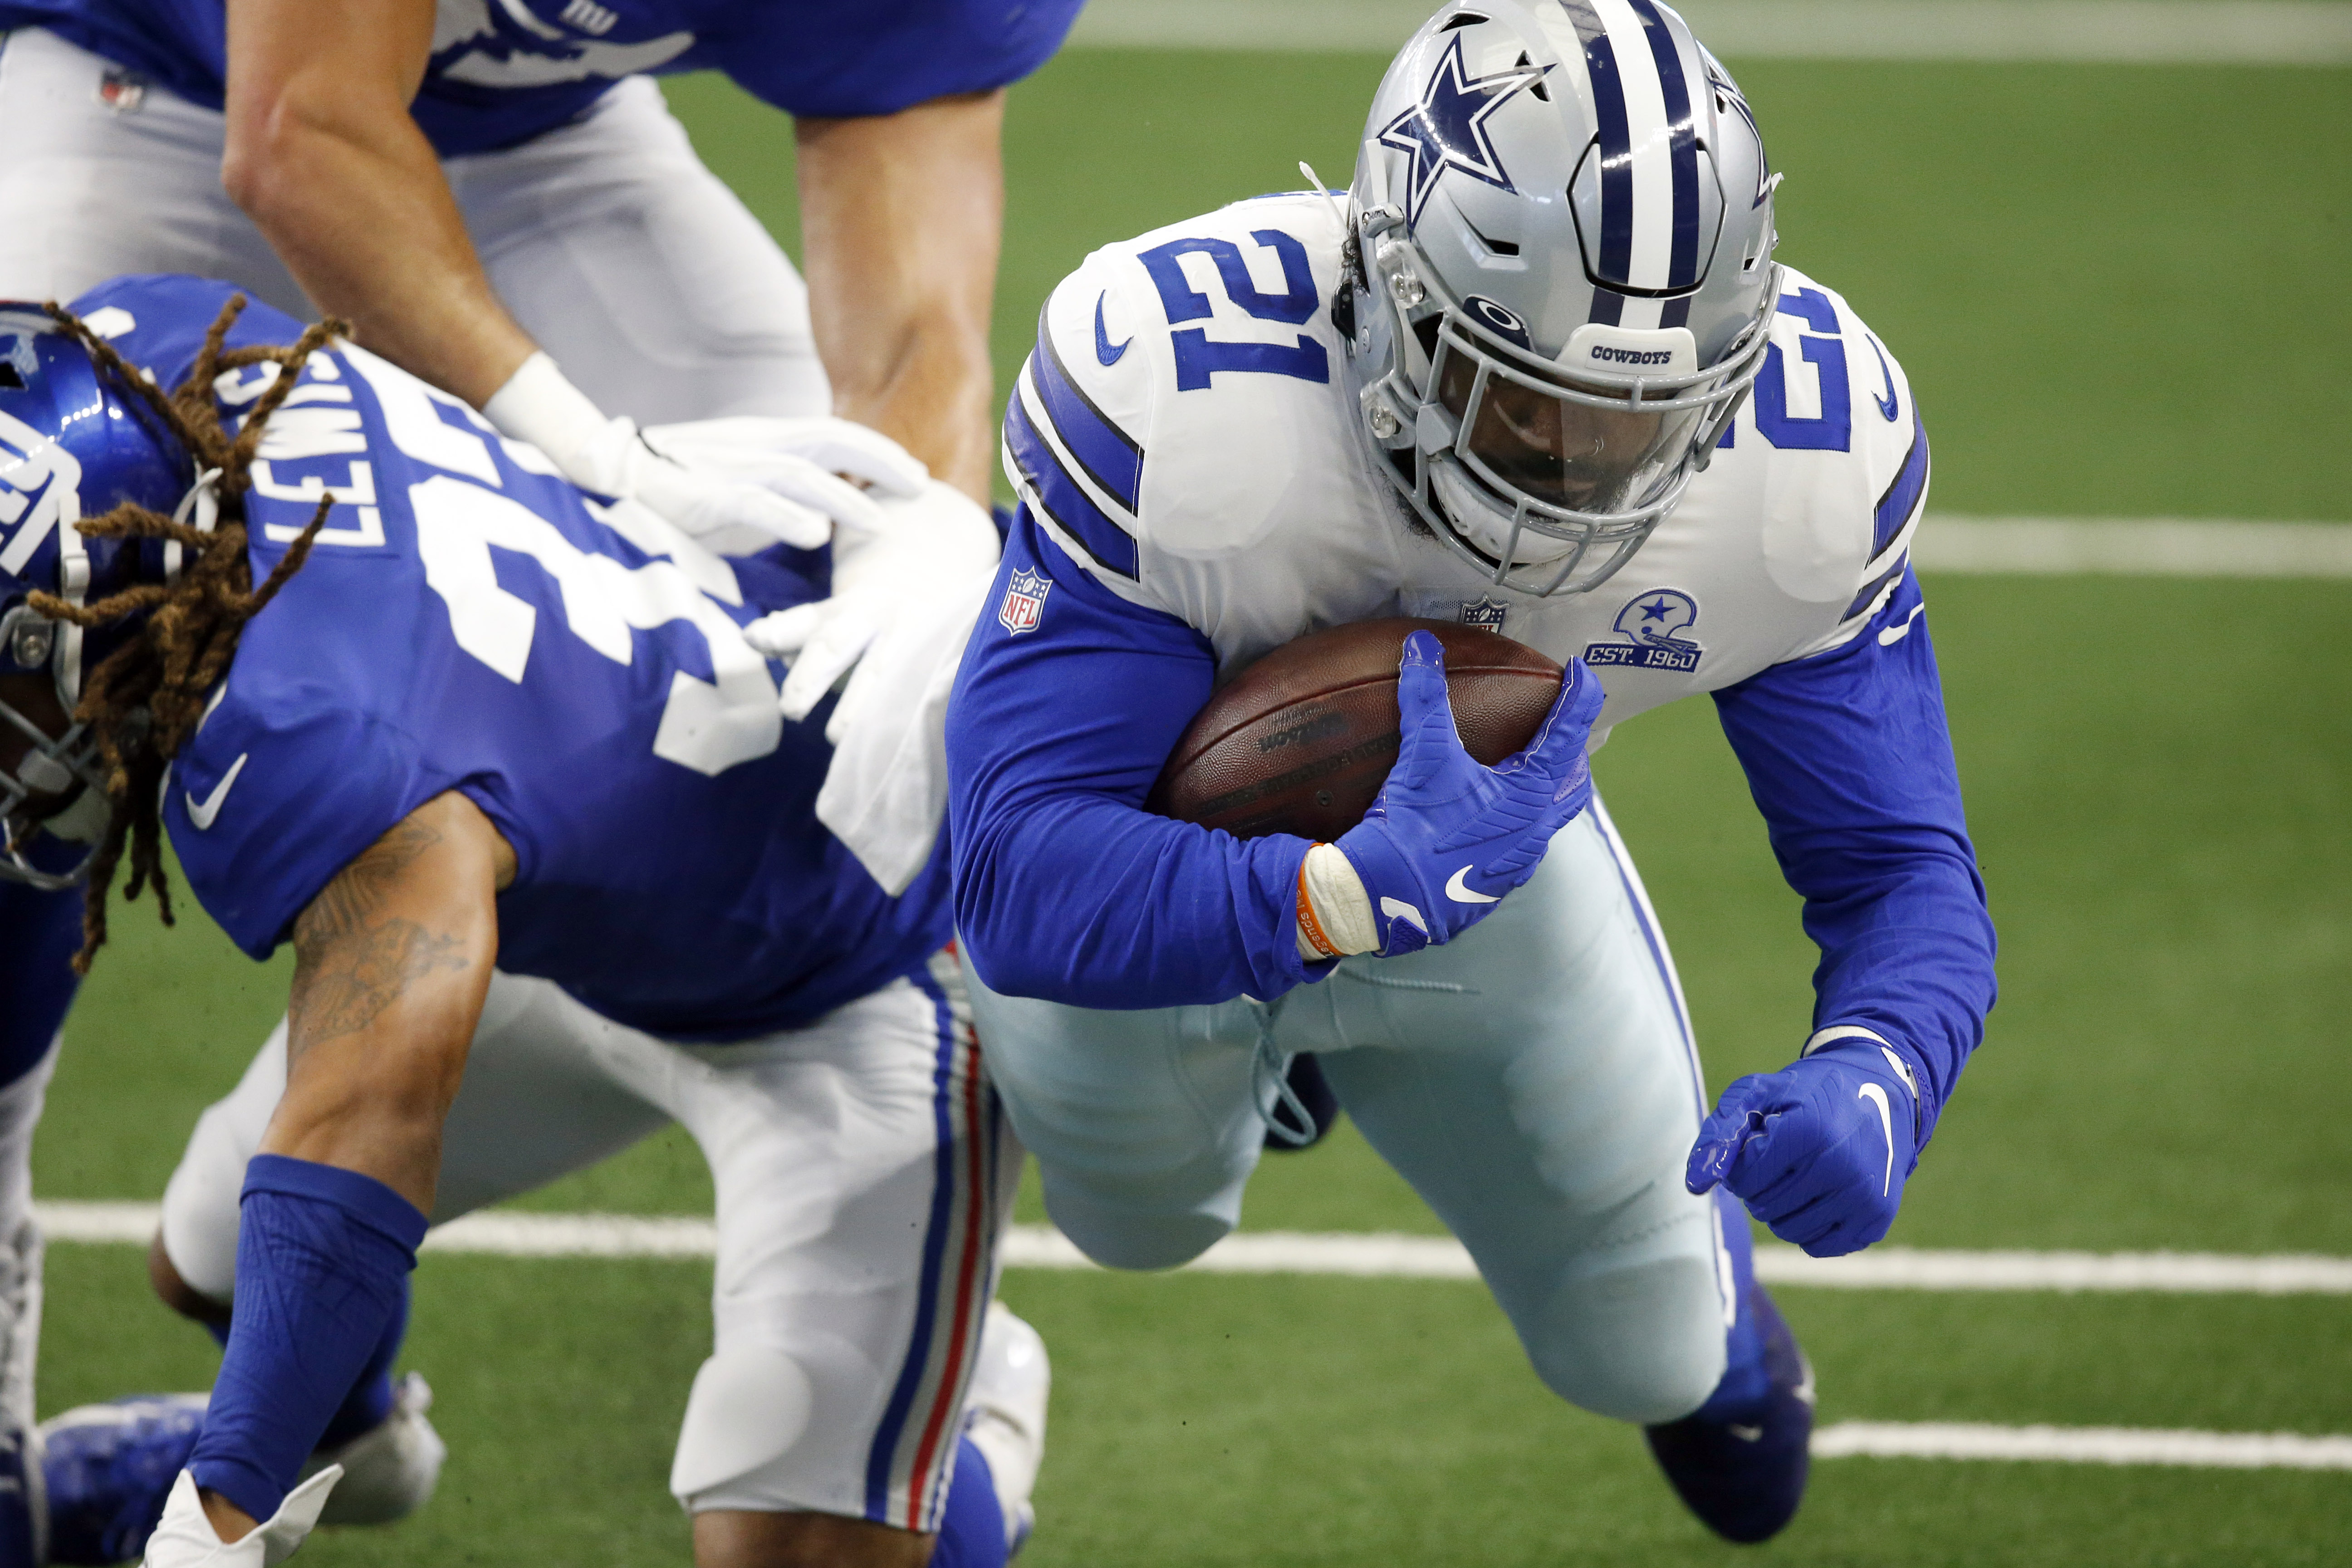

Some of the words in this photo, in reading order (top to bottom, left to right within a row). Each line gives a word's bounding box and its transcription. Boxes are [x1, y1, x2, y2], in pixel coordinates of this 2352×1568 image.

[1136, 228, 1329, 392] 21
[1591, 345, 1672, 364] COWBOYS
[212, 348, 387, 547] LEWIS
[1004, 594, 1035, 627] NFL
[1586, 647, 1633, 663] EST.
[1644, 649, 1696, 668] 1960
[1301, 912, 1334, 957] Legends
